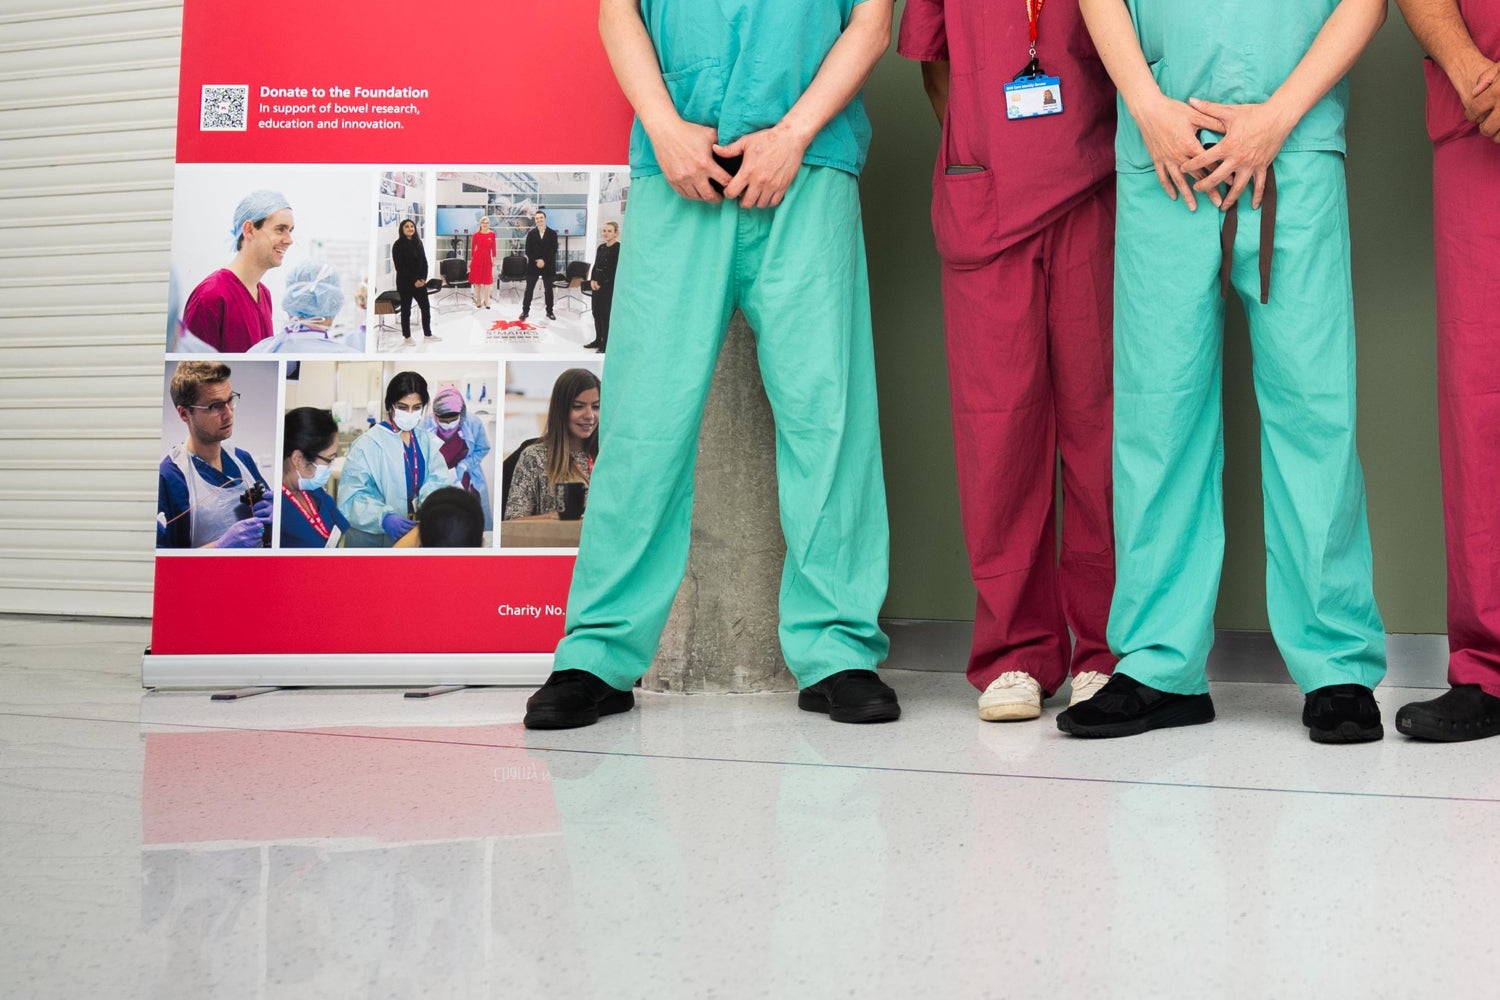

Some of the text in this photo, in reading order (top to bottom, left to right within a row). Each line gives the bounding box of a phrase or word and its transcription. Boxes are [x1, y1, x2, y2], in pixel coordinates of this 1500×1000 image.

[260, 86, 429, 99] Donate to the Foundation
[259, 102, 420, 116] In support of bowel research,
[258, 118, 404, 130] education and innovation.
[498, 604, 541, 618] Charity
